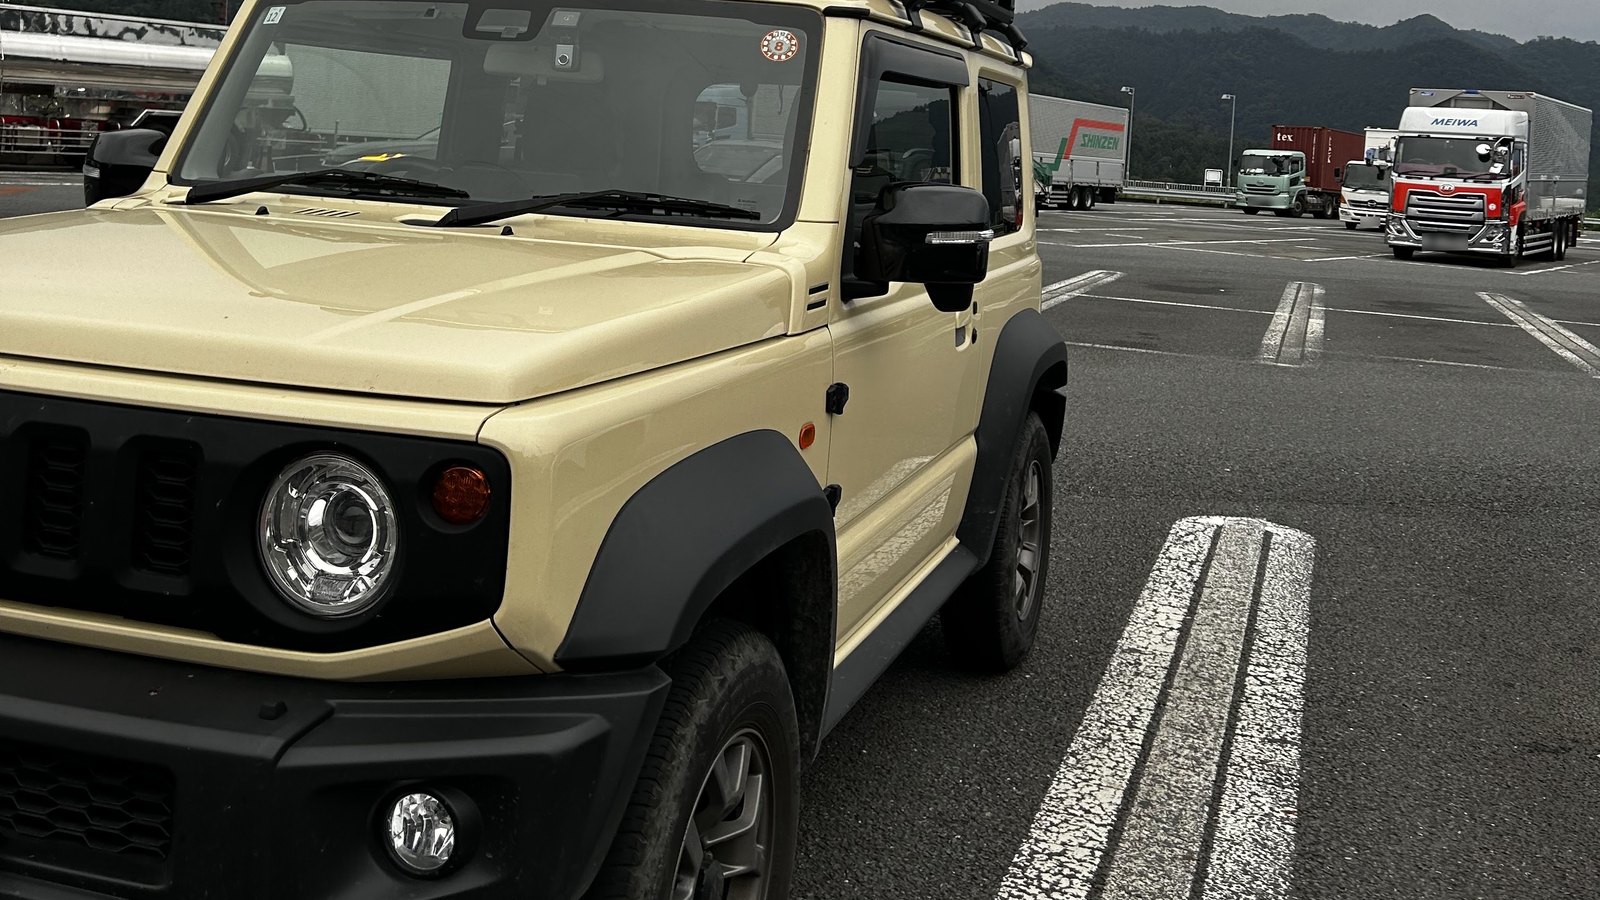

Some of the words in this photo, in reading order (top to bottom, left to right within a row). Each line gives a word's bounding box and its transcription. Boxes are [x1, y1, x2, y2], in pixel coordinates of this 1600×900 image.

[774, 41, 784, 51] 8
[1431, 118, 1478, 127] MEIWA
[1080, 133, 1120, 151] SHINZEN
[1276, 132, 1294, 142] tex
